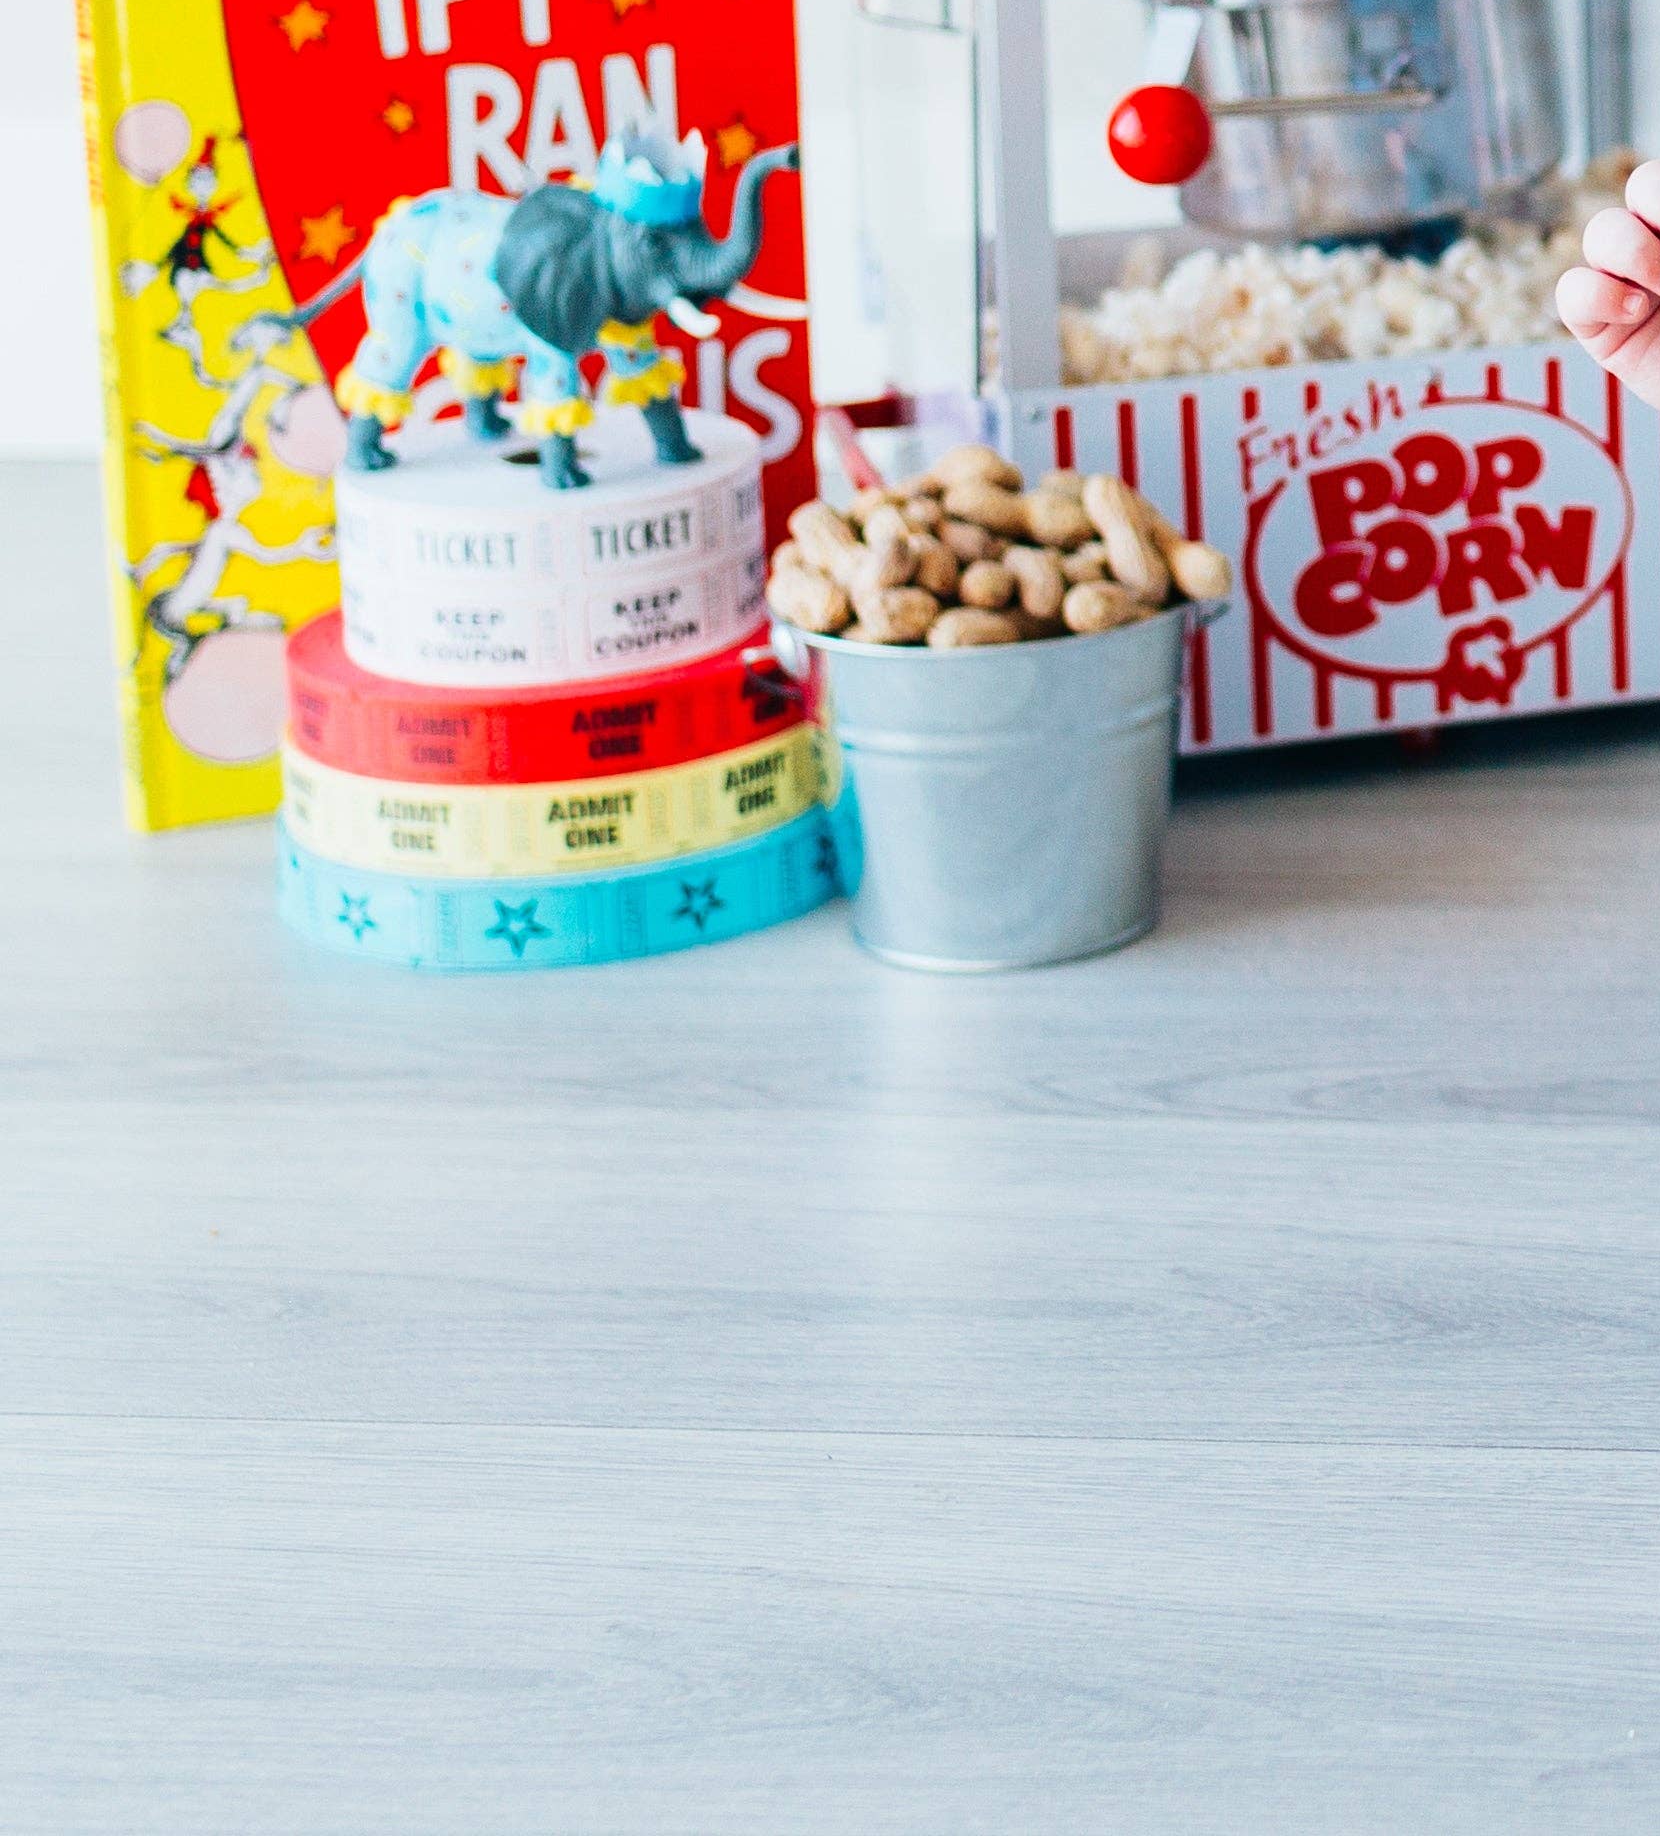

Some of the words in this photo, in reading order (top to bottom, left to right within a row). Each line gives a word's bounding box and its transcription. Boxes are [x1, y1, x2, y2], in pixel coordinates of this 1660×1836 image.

[445, 43, 679, 196] RAN
[1238, 379, 1403, 493] Fresh
[1308, 432, 1543, 554] POP
[414, 529, 518, 566] TICKET
[591, 508, 692, 561] TICKET
[1296, 503, 1596, 637] CORN
[613, 586, 682, 616] KEEP
[594, 620, 699, 657] COUPON
[571, 699, 658, 733] ADMIT
[589, 734, 643, 761] ONE
[725, 750, 786, 792] ADMIT
[547, 792, 636, 825] ADMIT
[564, 824, 618, 850] ONE
